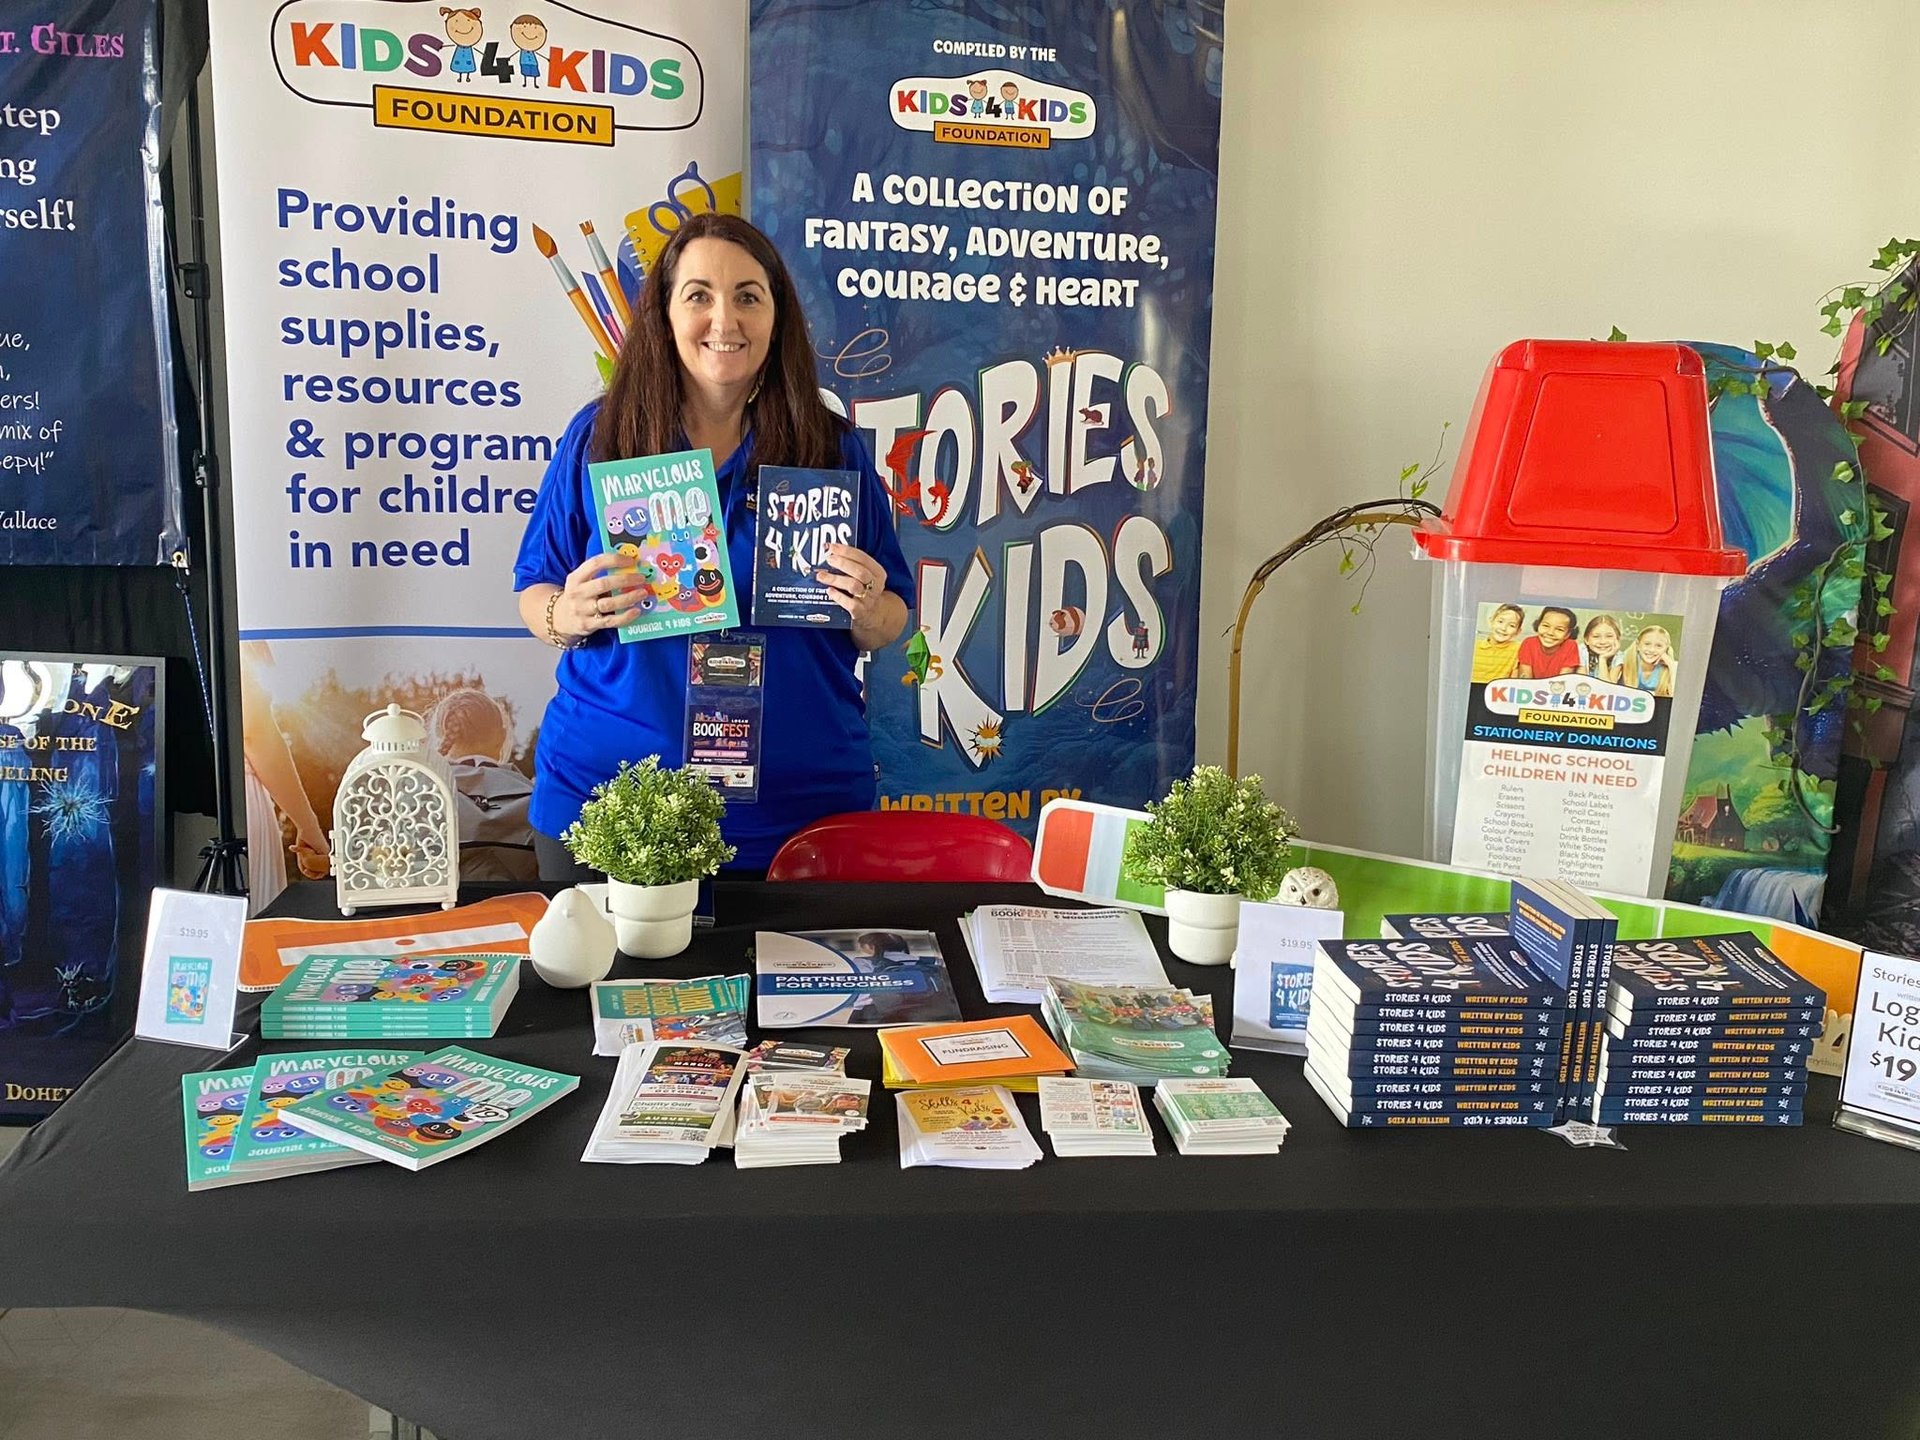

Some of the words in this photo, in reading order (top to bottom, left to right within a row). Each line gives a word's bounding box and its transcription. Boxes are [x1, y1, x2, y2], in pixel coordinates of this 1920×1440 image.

[31, 23, 125, 59] GILES
[933, 39, 1005, 59] COMPILED
[1009, 46, 1028, 59] BY
[1030, 47, 1057, 62] THE
[290, 22, 444, 77] KIDS
[481, 41, 515, 83] 4
[547, 46, 684, 100] KIDS
[0, 103, 60, 136] tep
[392, 97, 598, 136] FOUNDATION
[897, 90, 968, 117] KIDS
[985, 96, 1002, 118] 4
[1018, 98, 1087, 124] KIDS
[942, 127, 1042, 144] FOUNDATION
[852, 173, 874, 203] A
[1087, 186, 1129, 217] OF
[277, 188, 519, 254] Providing
[278, 248, 440, 294] school
[1009, 272, 1027, 307] &
[280, 308, 499, 359] supplies,
[283, 373, 521, 408] resources
[39, 421, 62, 443] of
[285, 418, 325, 458] &
[344, 431, 561, 471] program
[818, 352, 1172, 528] TORIES
[285, 473, 361, 514] for
[379, 474, 538, 514] childre
[601, 459, 703, 505] MARVELOUS
[767, 485, 852, 527] STORIES
[289, 530, 332, 568] in
[352, 528, 471, 568] need
[764, 526, 783, 569] 4
[917, 514, 1173, 768] KIDS
[1491, 687, 1549, 704] KIDS
[1562, 692, 1576, 707] 4
[1589, 694, 1647, 713] KIDS
[1525, 712, 1608, 727] FOUNDATION
[24, 736, 50, 751] OF
[56, 737, 97, 751] THE
[1473, 725, 1564, 743] STATIONERY
[1568, 732, 1658, 750] DONATIONS
[1491, 749, 1562, 766] HELPING
[1566, 755, 1635, 771] SCHOOL
[1484, 764, 1567, 782] CHILDREN
[1572, 771, 1589, 783] IN
[1593, 773, 1638, 789] NEED
[1562, 799, 1587, 807] School
[1483, 817, 1509, 826] School
[1280, 938, 1312, 950] $19.95
[775, 974, 891, 983] PARTNERING
[776, 981, 814, 989] FOR
[818, 979, 914, 989] PROGRESS
[1276, 972, 1312, 989] STORIE
[1275, 988, 1285, 1006] 4
[1288, 988, 1311, 1010] KID
[1385, 994, 1420, 1003] STORIES
[1432, 994, 1451, 1003] KIDS
[1465, 996, 1498, 1004] WRITTEN
[1510, 996, 1528, 1004] KIDS
[942, 1043, 1010, 1055] FUNDRAISING
[270, 1055, 410, 1077] MARVELOUS
[431, 1053, 560, 1090] MARVELOUS
[1623, 1113, 1658, 1122] STORIES
[1669, 1113, 1689, 1122] KIDS
